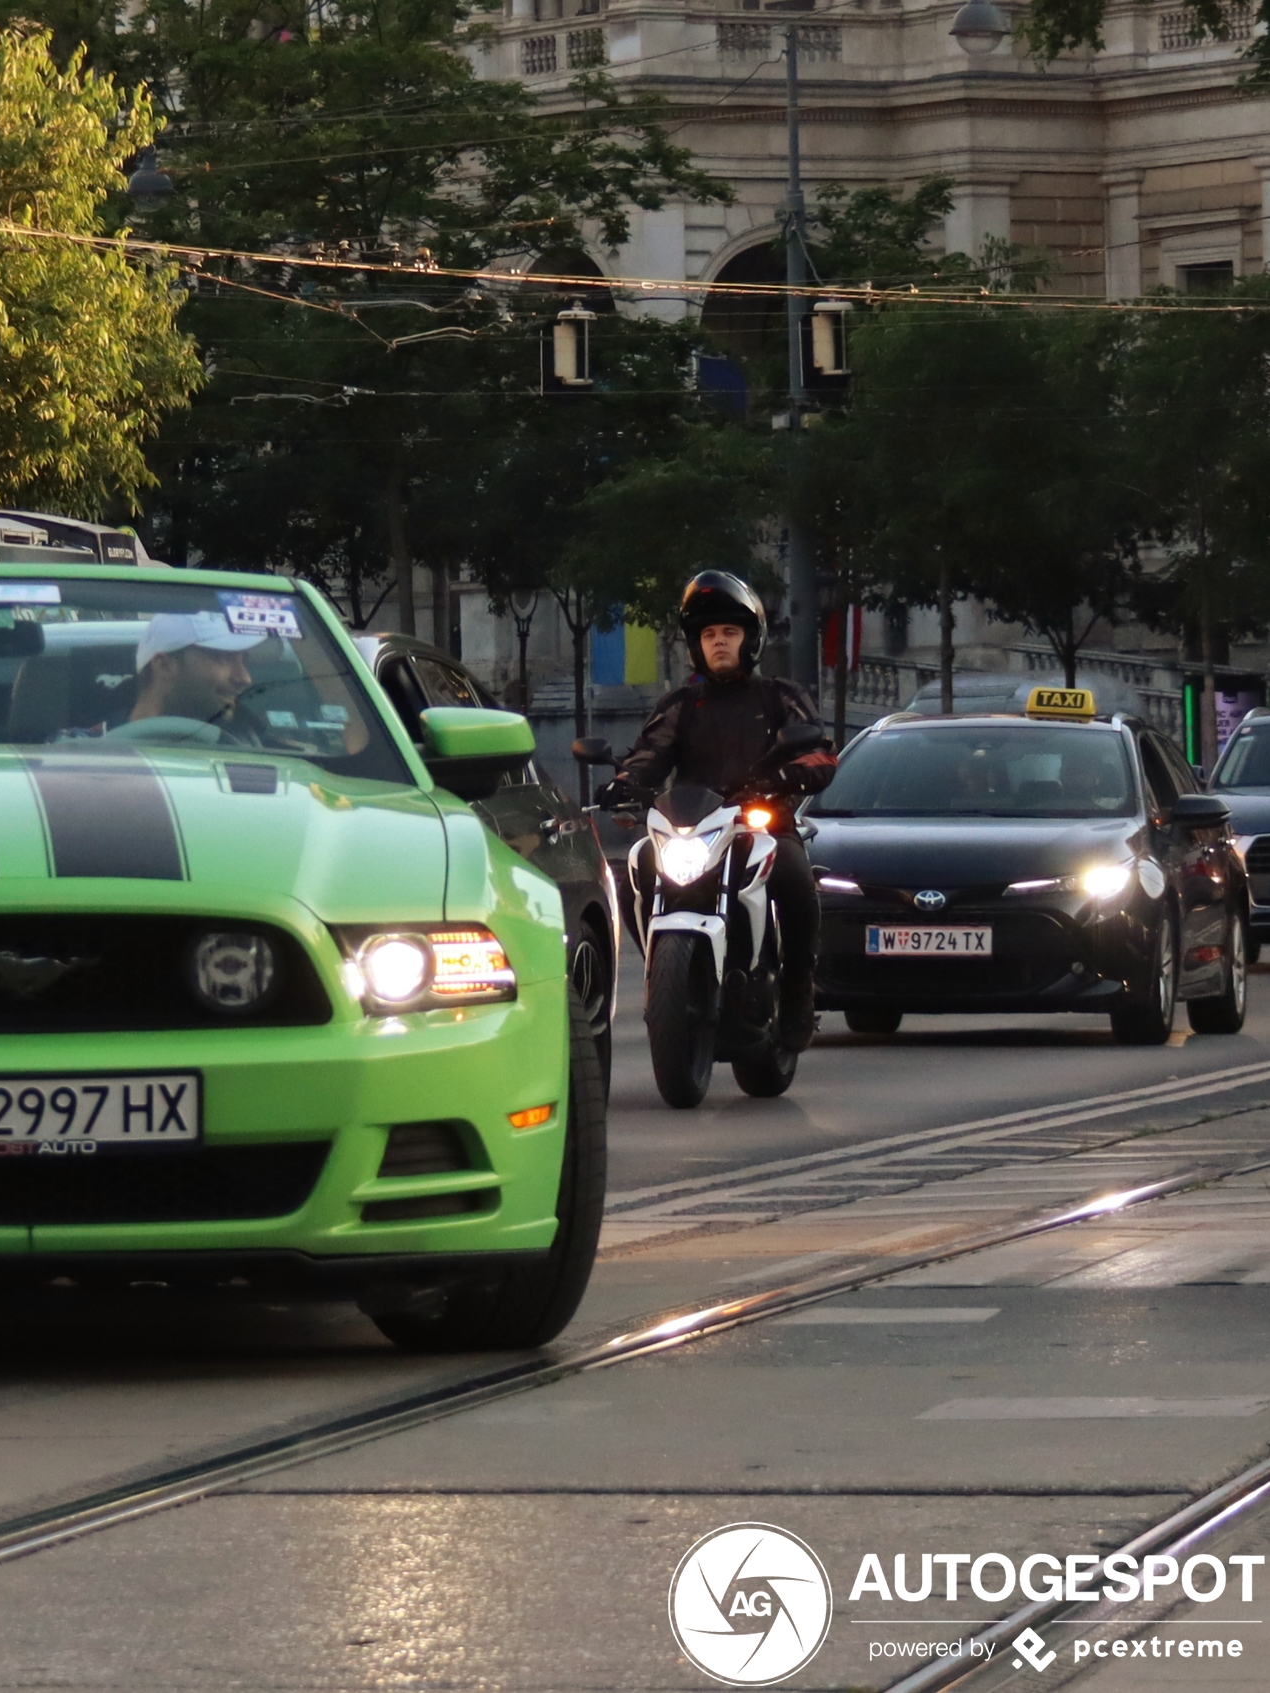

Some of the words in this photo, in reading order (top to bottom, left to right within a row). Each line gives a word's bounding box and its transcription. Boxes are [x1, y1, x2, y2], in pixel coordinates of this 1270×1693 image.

[1040, 692, 1083, 707] TAXI
[882, 931, 896, 950] W
[911, 931, 957, 951] 9724
[962, 931, 985, 950] TX
[121, 1082, 188, 1134] HX
